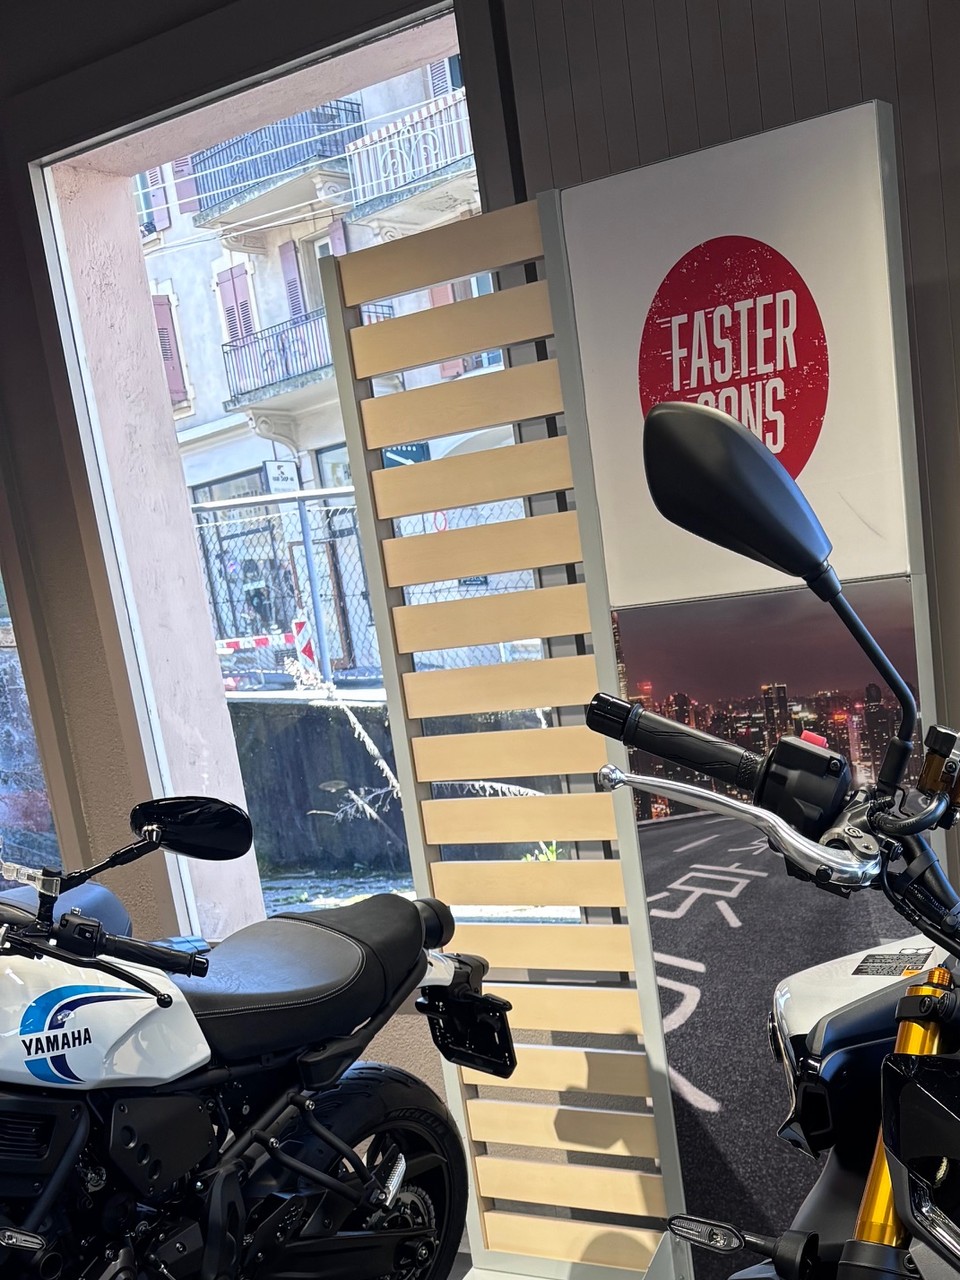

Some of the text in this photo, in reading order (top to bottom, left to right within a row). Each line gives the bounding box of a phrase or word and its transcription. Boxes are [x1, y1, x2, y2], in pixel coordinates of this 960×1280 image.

[671, 289, 797, 392] FASTER
[696, 377, 786, 454] NS
[21, 1027, 93, 1057] YAMAHA
